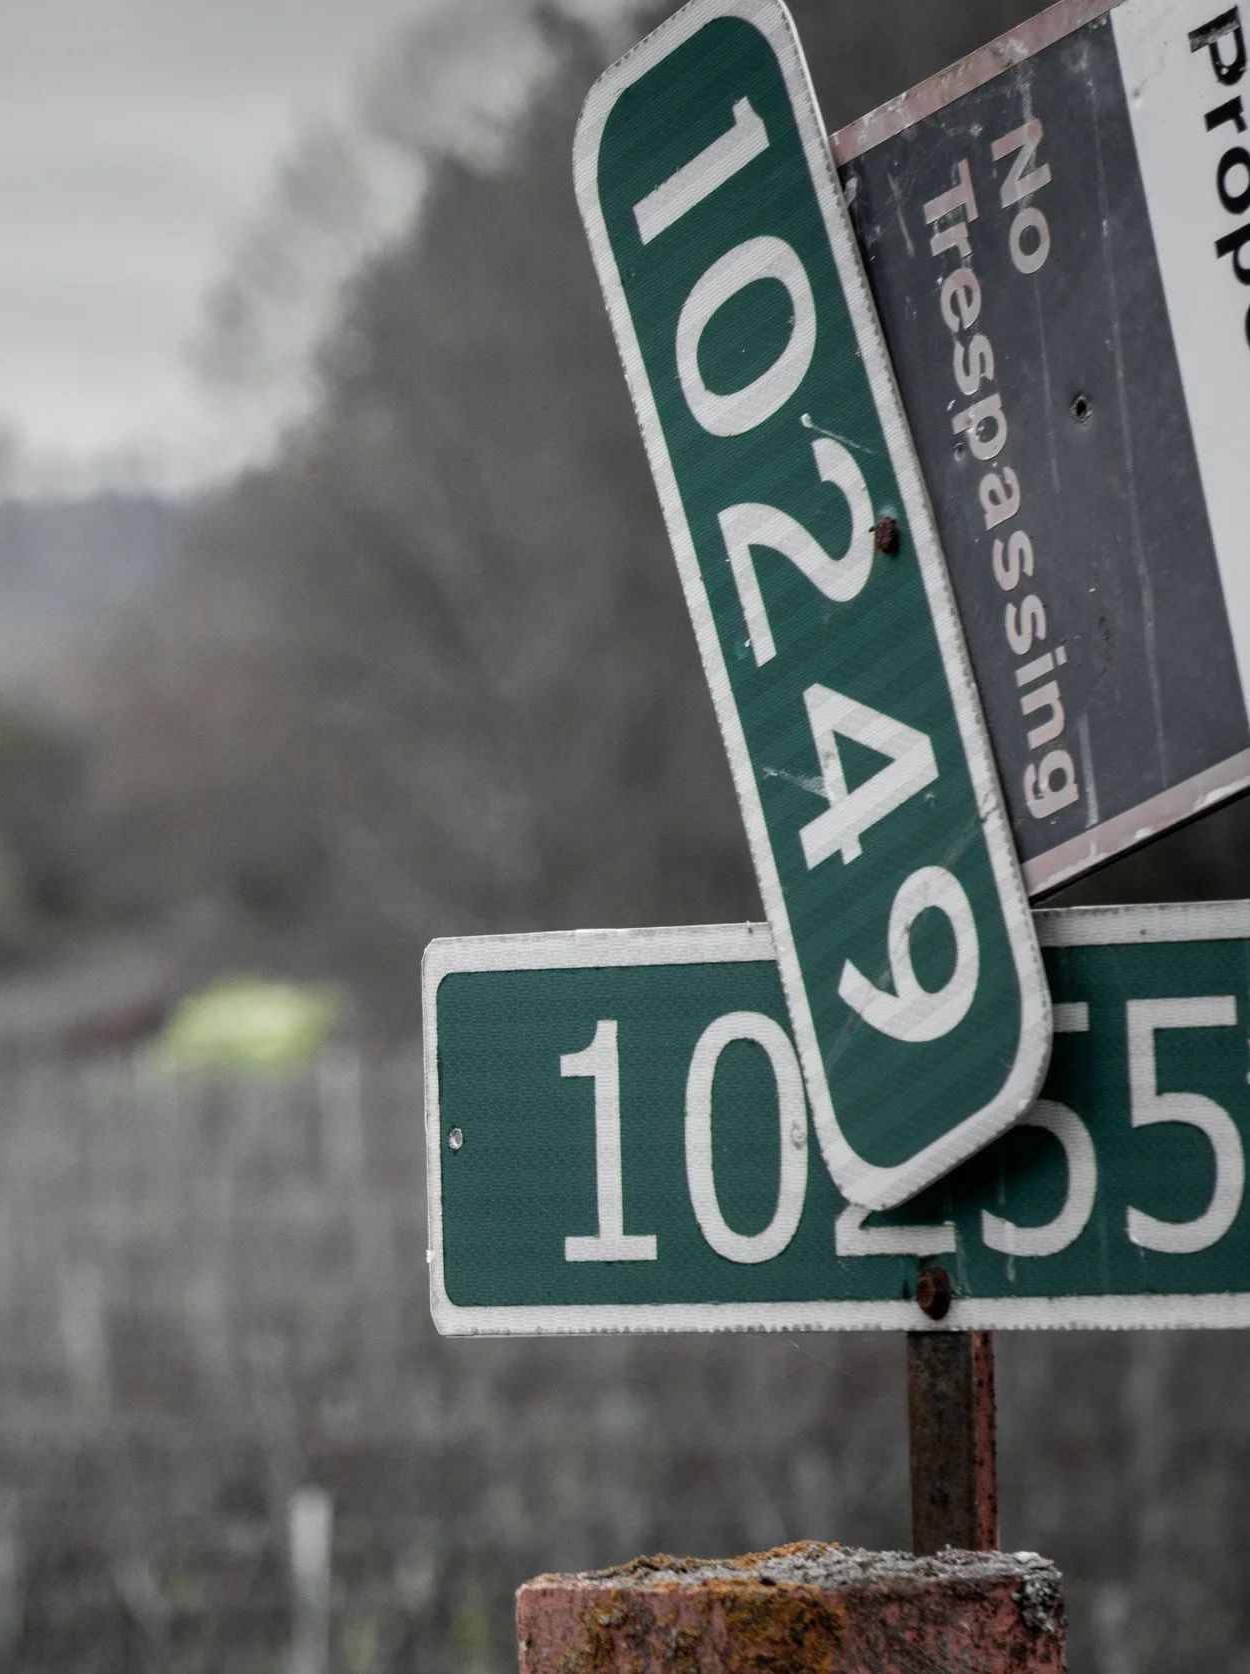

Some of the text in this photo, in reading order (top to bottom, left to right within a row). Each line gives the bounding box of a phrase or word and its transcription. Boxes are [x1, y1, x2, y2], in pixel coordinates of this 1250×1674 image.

[923, 159, 1080, 819] Trespassing
[991, 117, 1051, 274] No
[632, 96, 980, 1042] 10249
